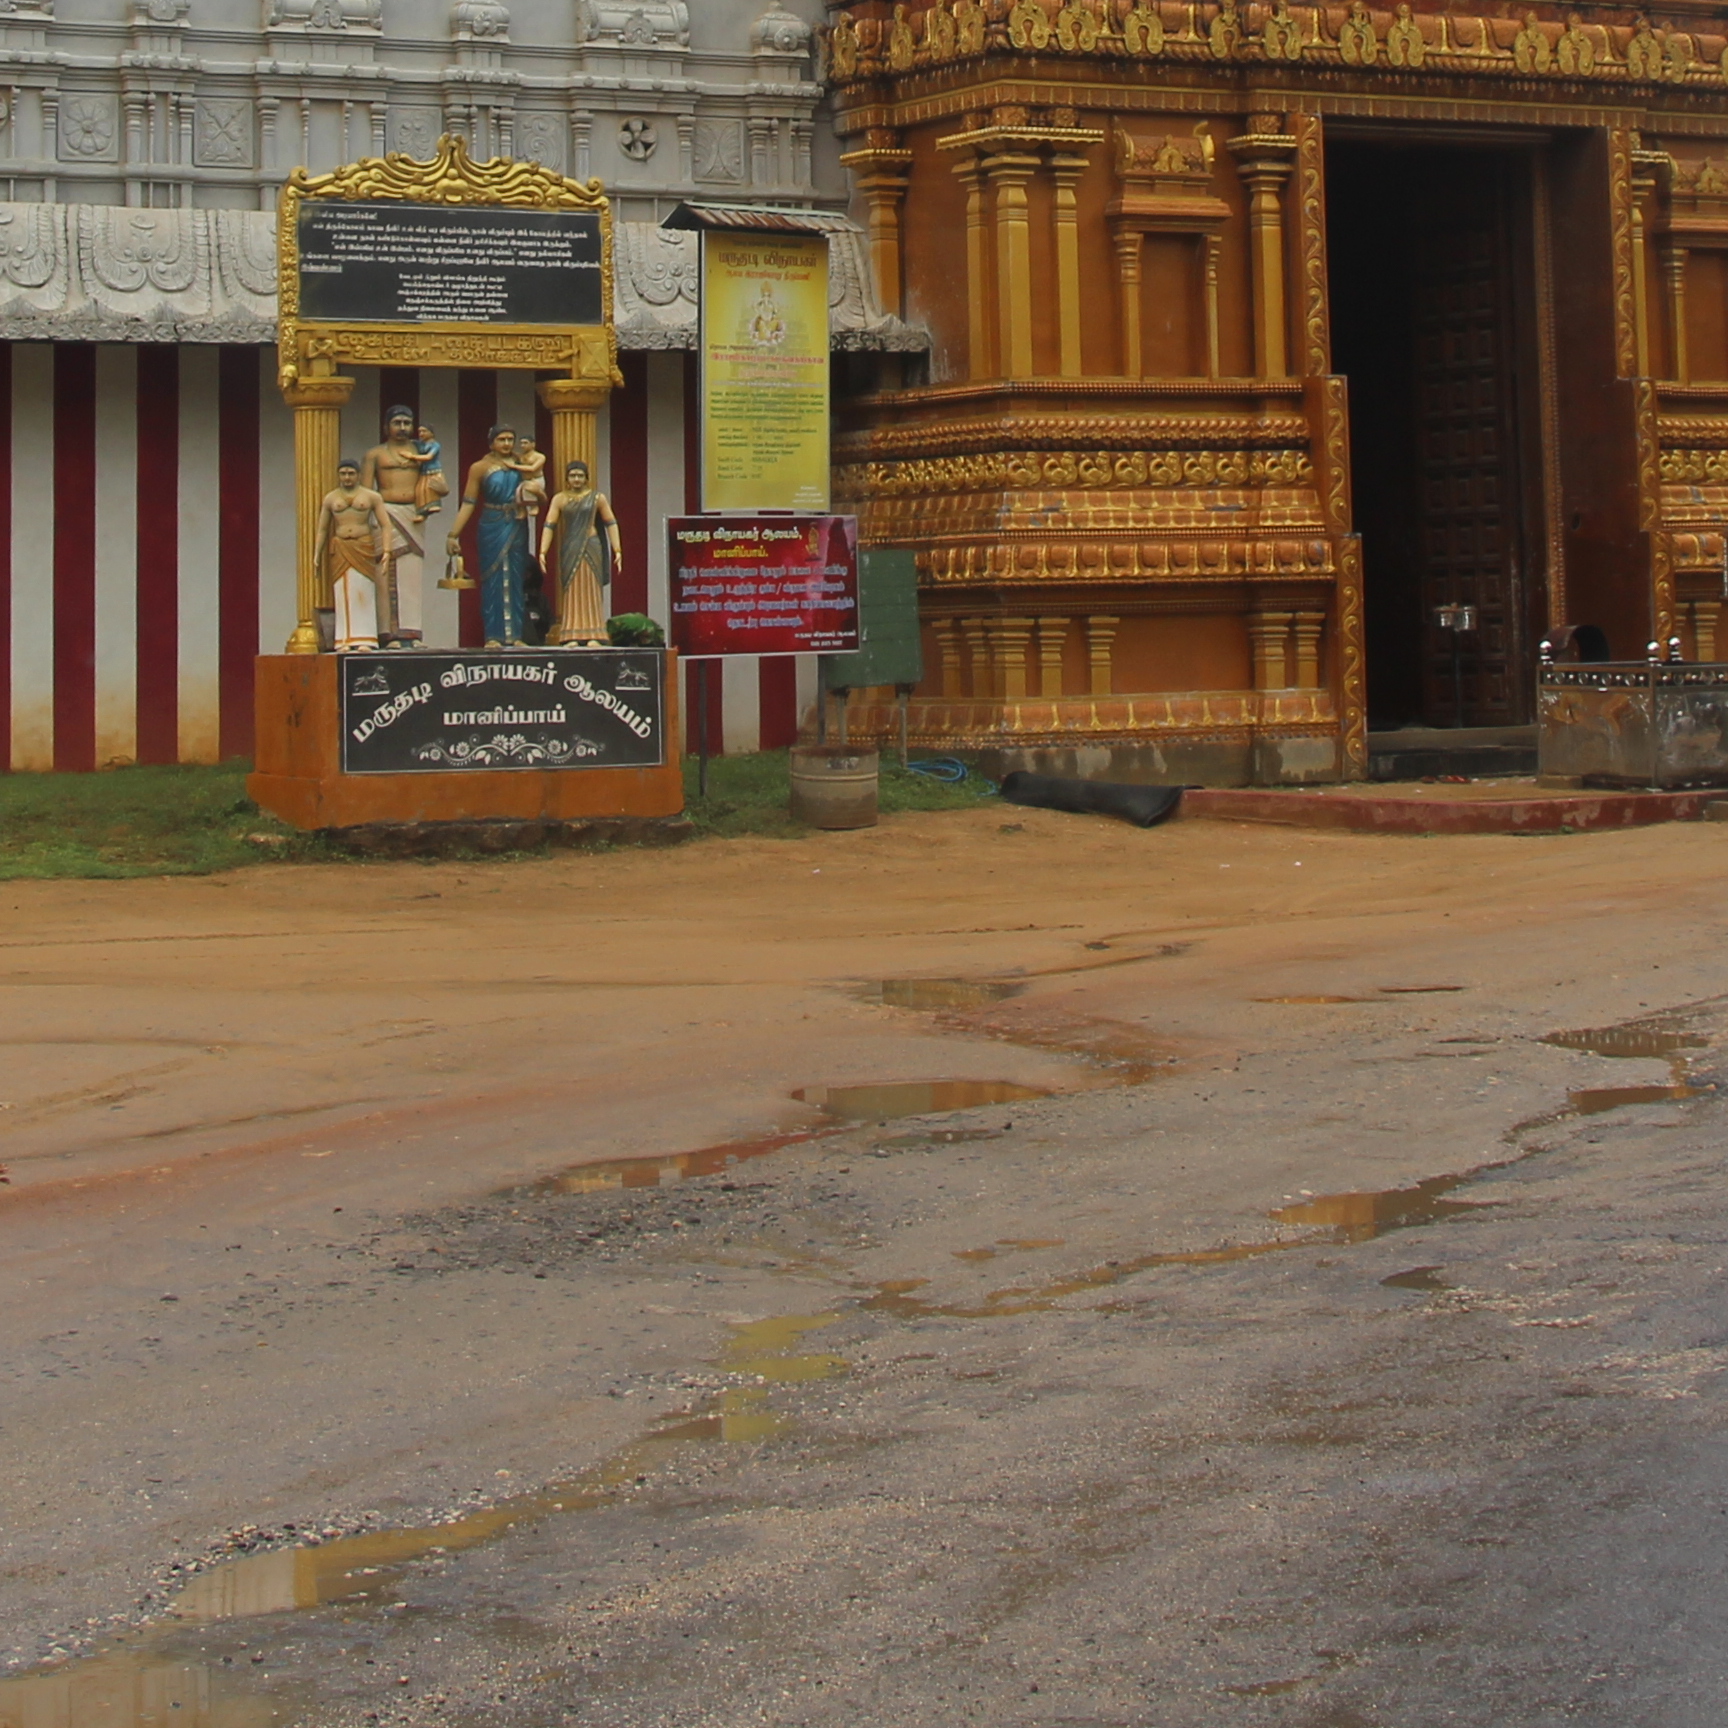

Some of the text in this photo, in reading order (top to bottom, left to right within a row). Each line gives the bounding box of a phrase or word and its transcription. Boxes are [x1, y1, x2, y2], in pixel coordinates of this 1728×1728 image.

[719, 251, 817, 268] மருதடி விநாயகர்
[677, 530, 710, 543] மருதடி
[713, 527, 759, 541] விநாயகர்
[352, 660, 652, 744] மருதடி விநாயகர் ஆலயம்
[442, 702, 567, 726] மானிப்பாய்
